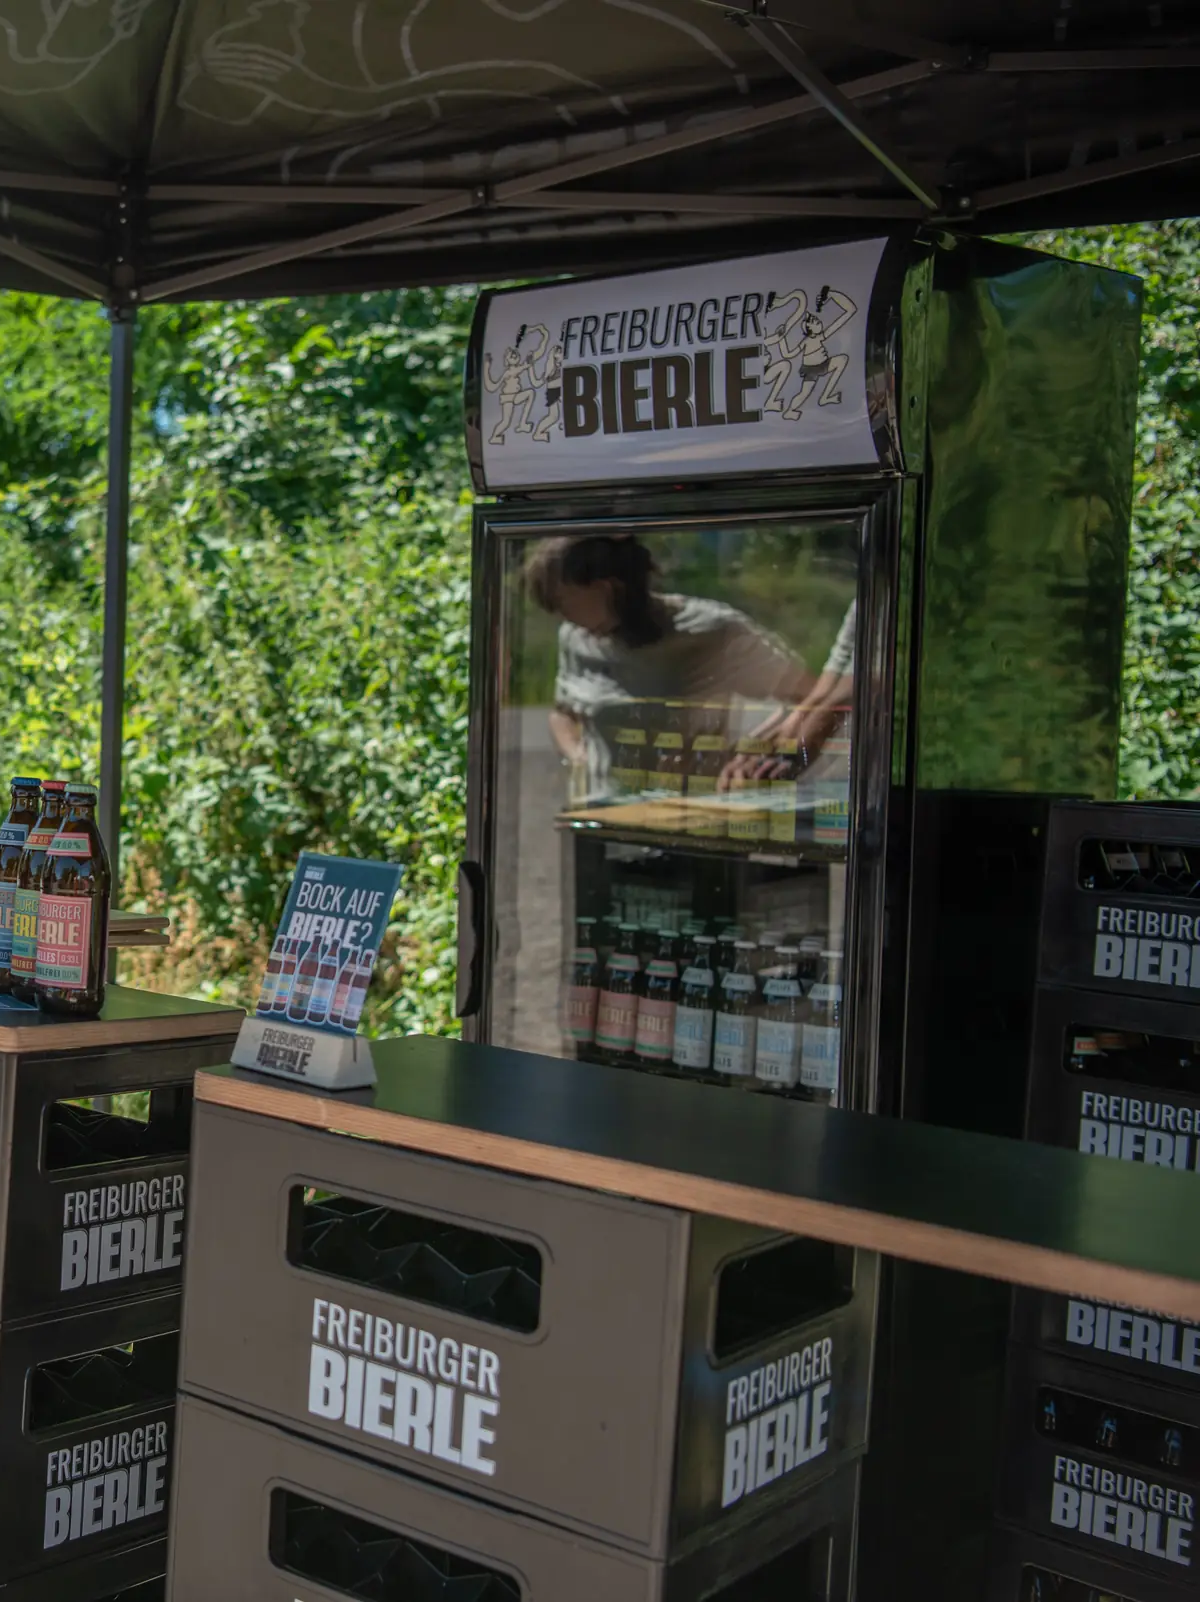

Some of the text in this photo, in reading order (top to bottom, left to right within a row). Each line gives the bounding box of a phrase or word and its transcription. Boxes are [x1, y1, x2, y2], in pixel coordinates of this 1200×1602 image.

[563, 292, 764, 360] FREIBURGER
[562, 345, 764, 438] BIERLE
[40, 902, 81, 920] BURGER
[40, 920, 80, 946] ERLE
[296, 880, 384, 918] BOCK AUF
[262, 1028, 316, 1051] FREIBURGER
[63, 1174, 184, 1228] FREIBURGER
[60, 1209, 184, 1291] BIERLE
[311, 1298, 500, 1396] FREIBURGER
[726, 1337, 833, 1426] FREIBURGER
[308, 1343, 499, 1477] BIERLE
[721, 1385, 832, 1509] BIERLE
[47, 1421, 168, 1487] FREIBURGER
[1055, 1455, 1194, 1521] FREIBURGER
[43, 1456, 167, 1550] BIERLE
[1051, 1482, 1194, 1567] BIERLE
